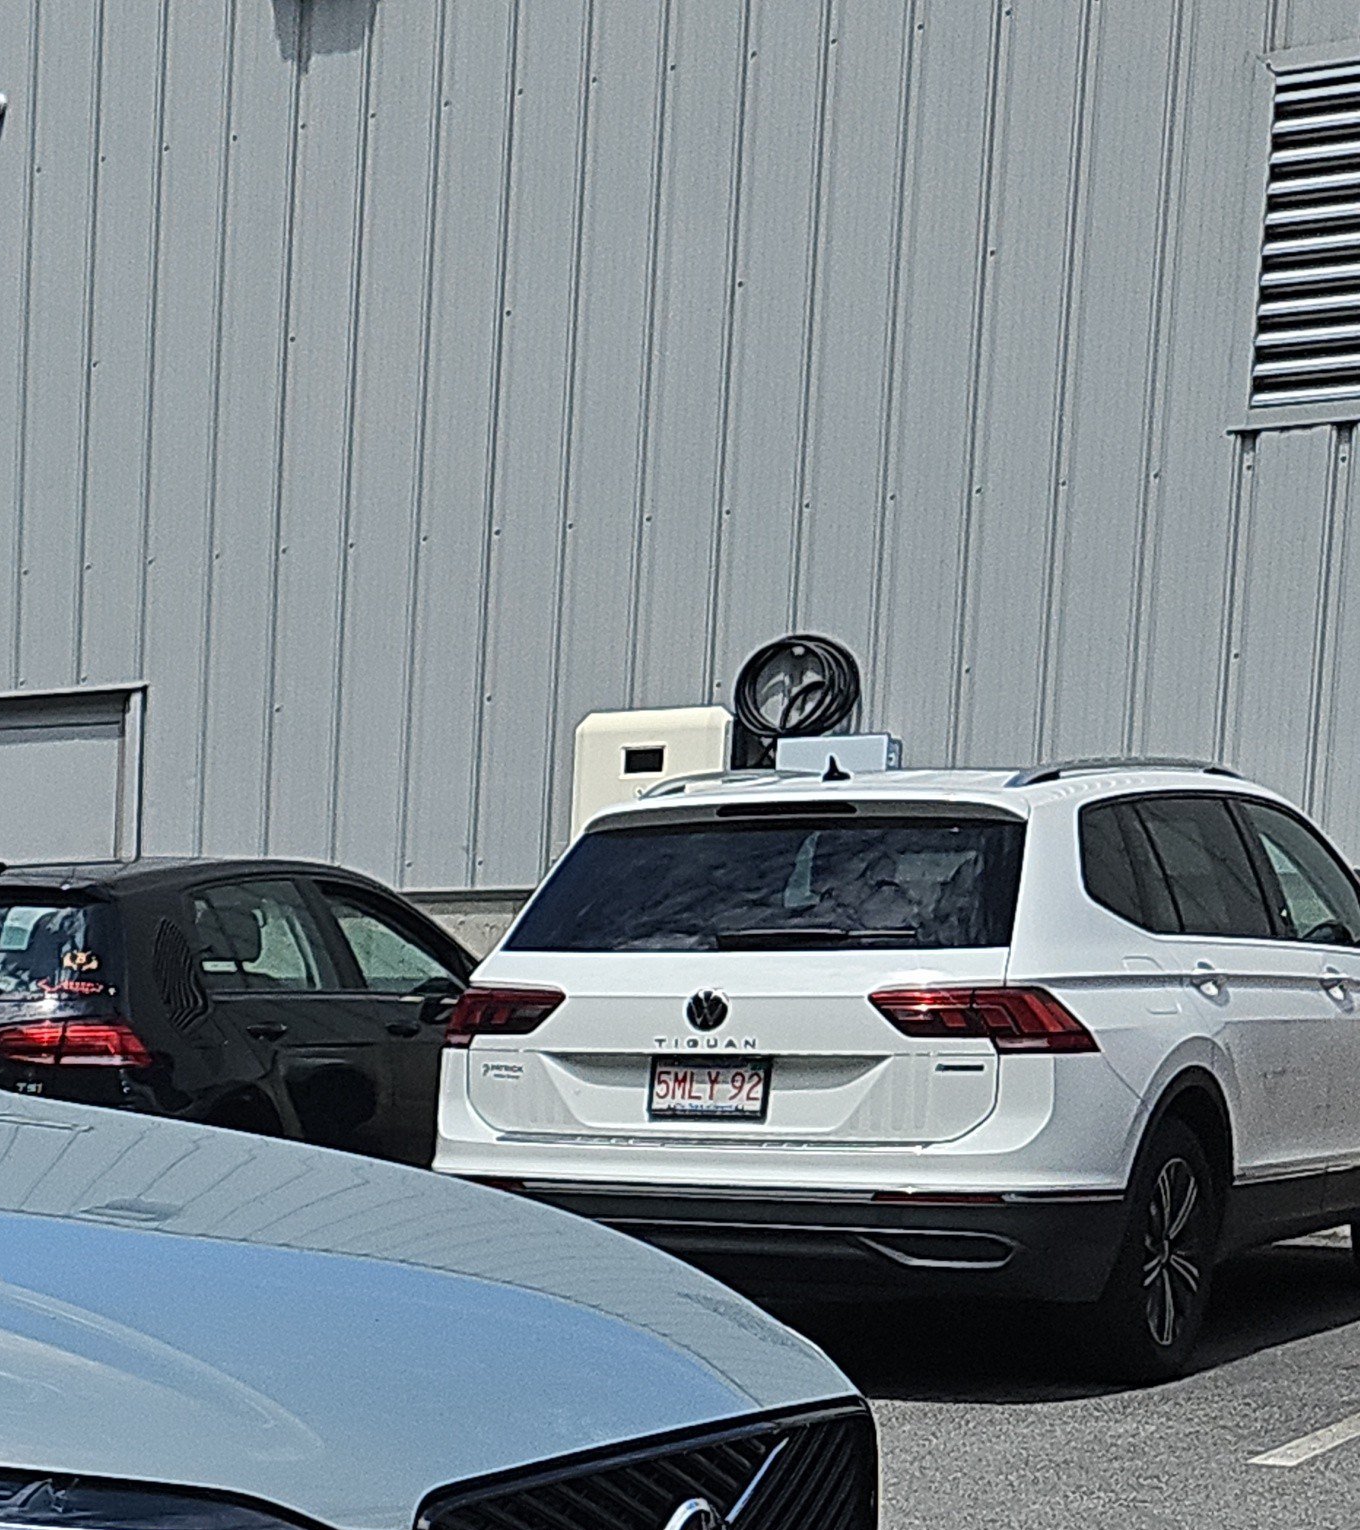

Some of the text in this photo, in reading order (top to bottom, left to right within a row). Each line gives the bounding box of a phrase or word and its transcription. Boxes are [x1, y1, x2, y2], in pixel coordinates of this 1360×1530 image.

[654, 1038, 756, 1049] TIGUAN
[656, 1069, 763, 1101] 5MLY 92
